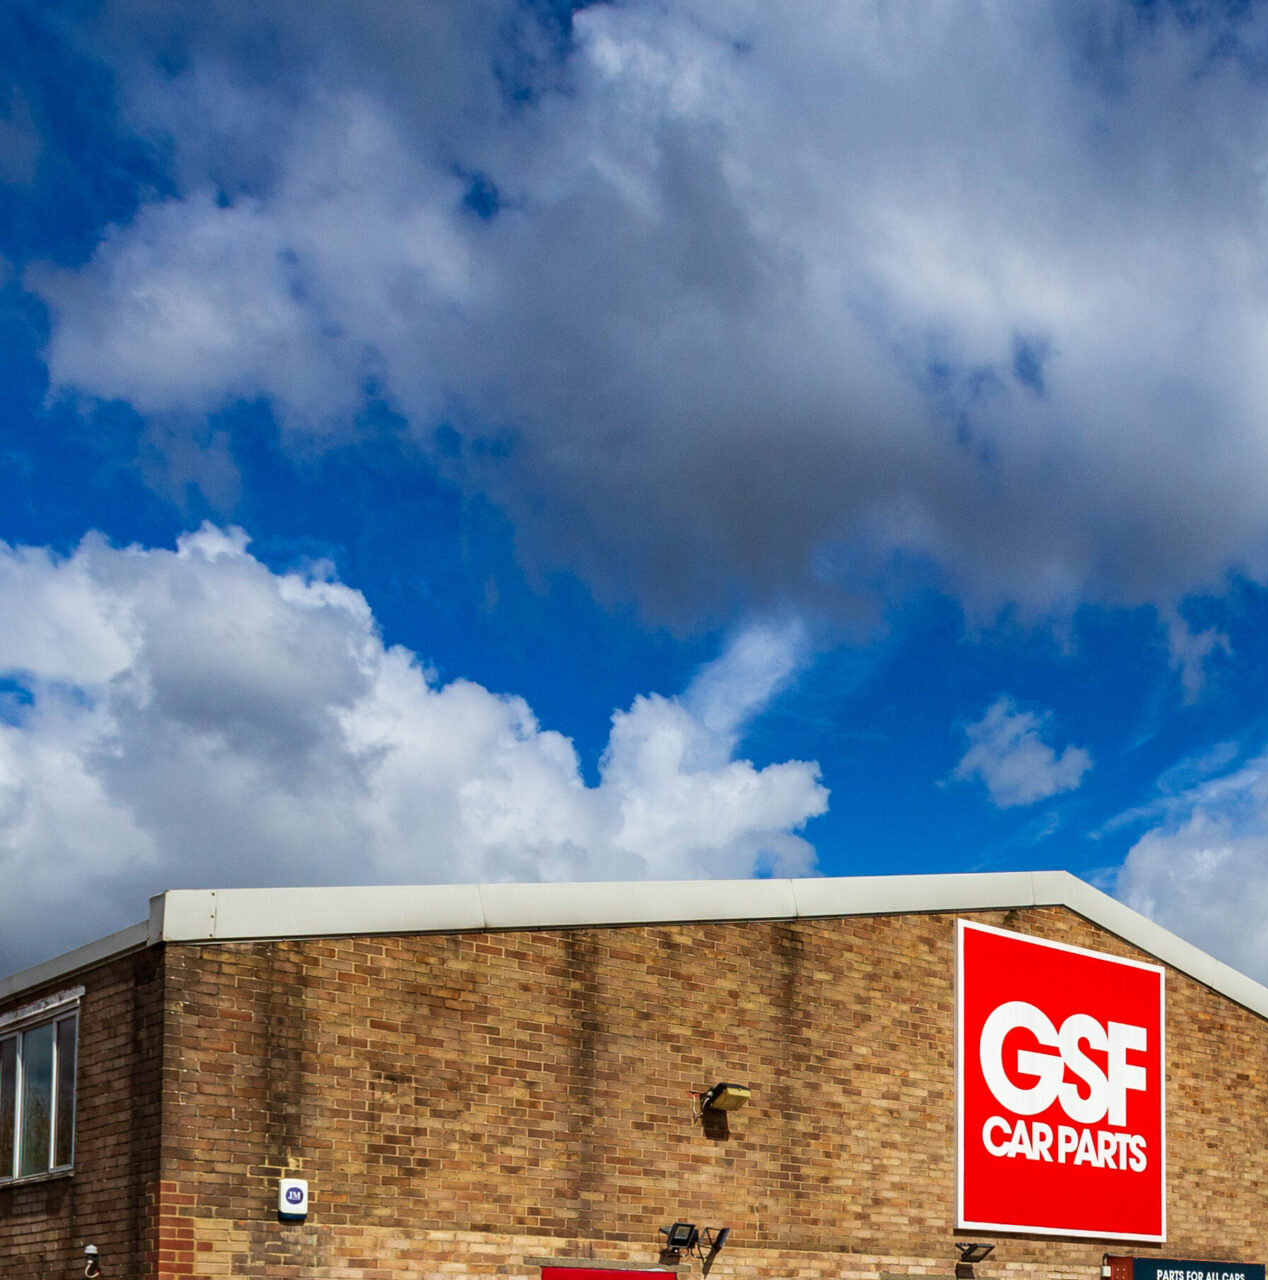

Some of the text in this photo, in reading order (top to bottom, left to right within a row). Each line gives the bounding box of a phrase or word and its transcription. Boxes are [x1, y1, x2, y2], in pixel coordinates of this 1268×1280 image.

[980, 1001, 1147, 1127] GSF
[982, 1115, 1147, 1172] CAR PARTS
